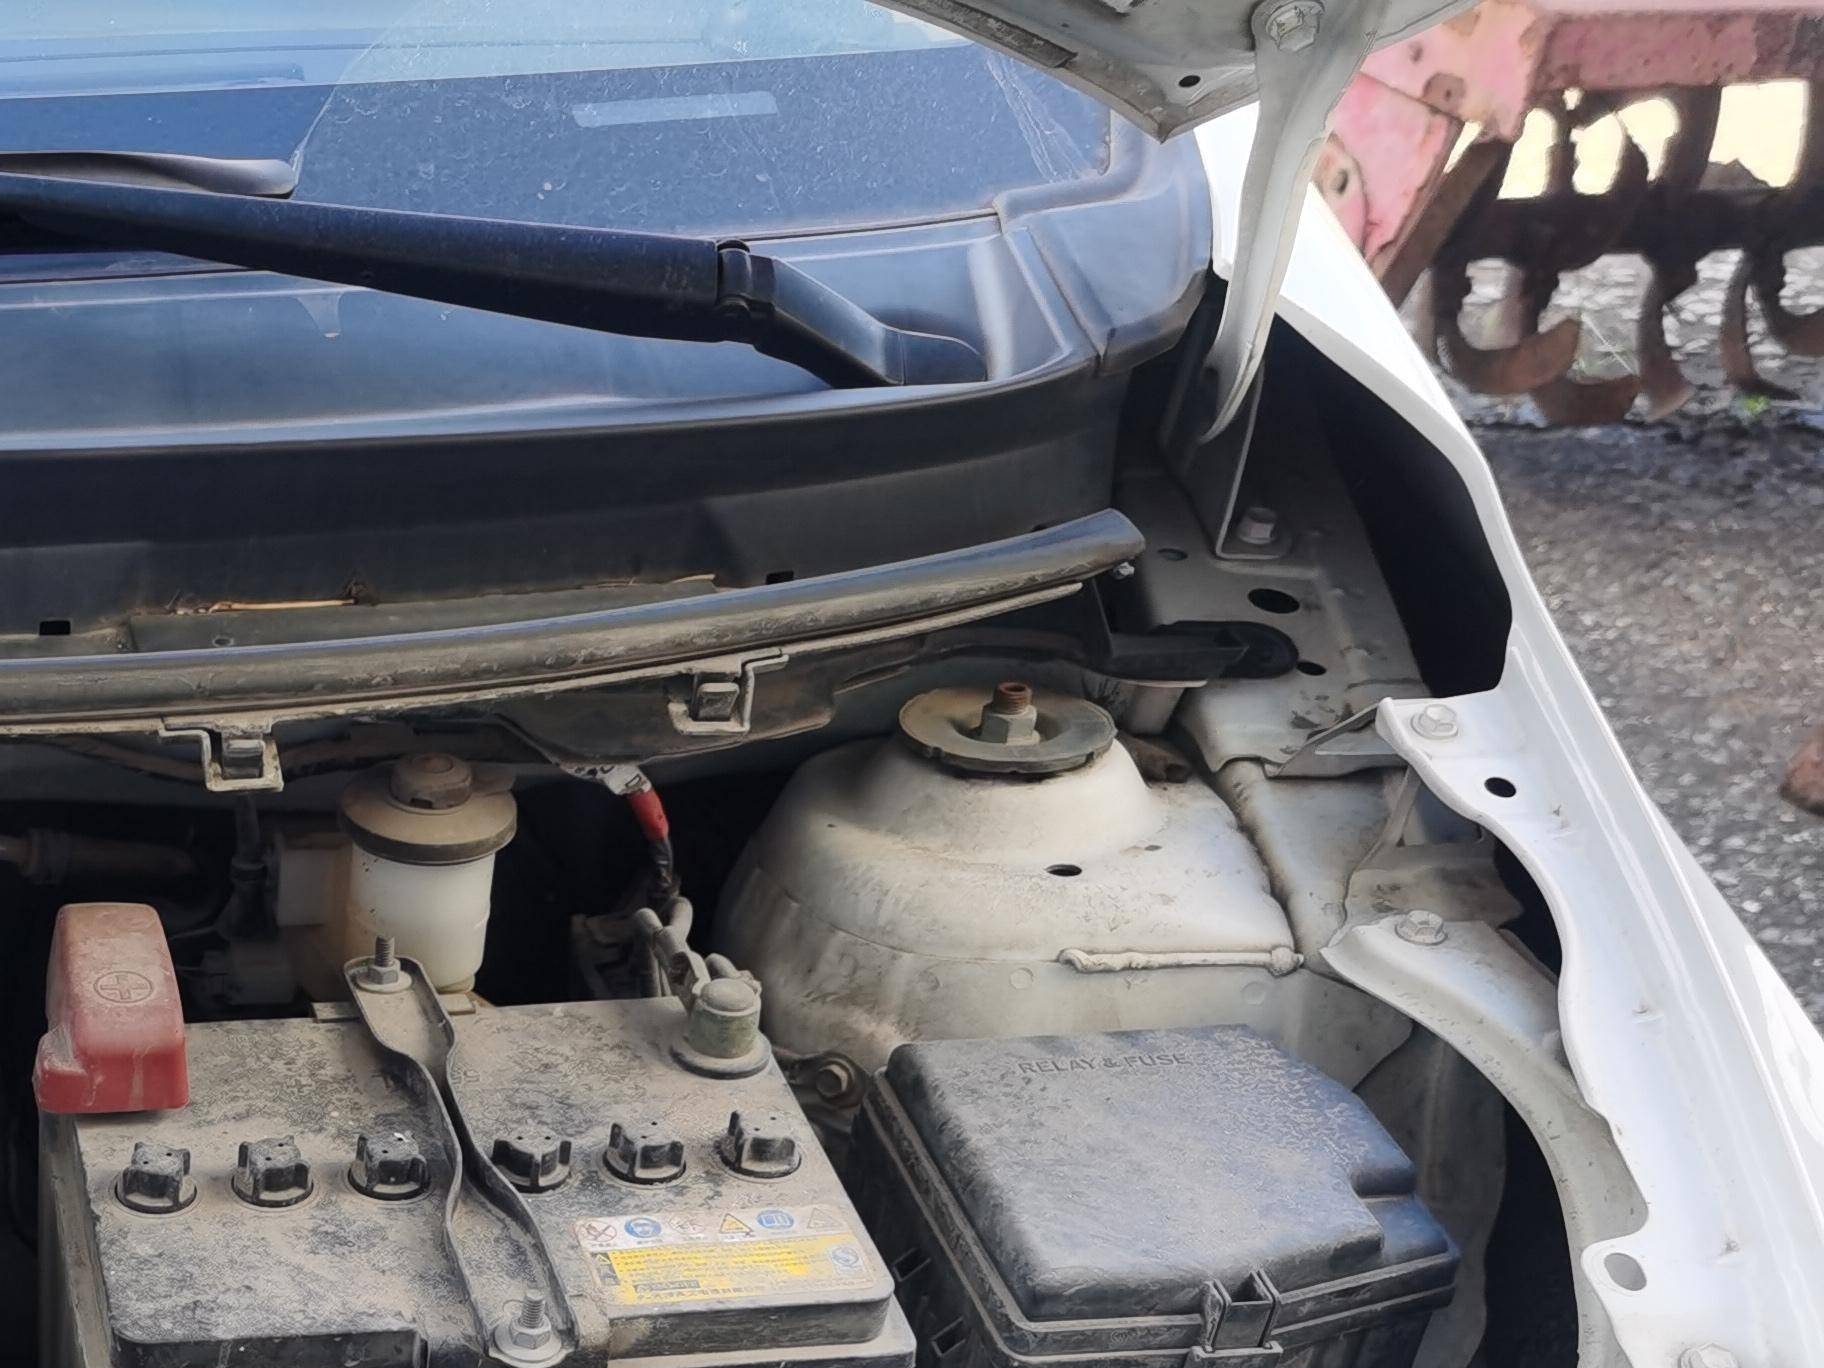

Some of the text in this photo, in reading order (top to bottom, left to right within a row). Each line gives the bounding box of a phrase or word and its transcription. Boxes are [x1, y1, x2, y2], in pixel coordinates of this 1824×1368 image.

[1017, 1052, 1193, 1074] RELAY & FUSE
